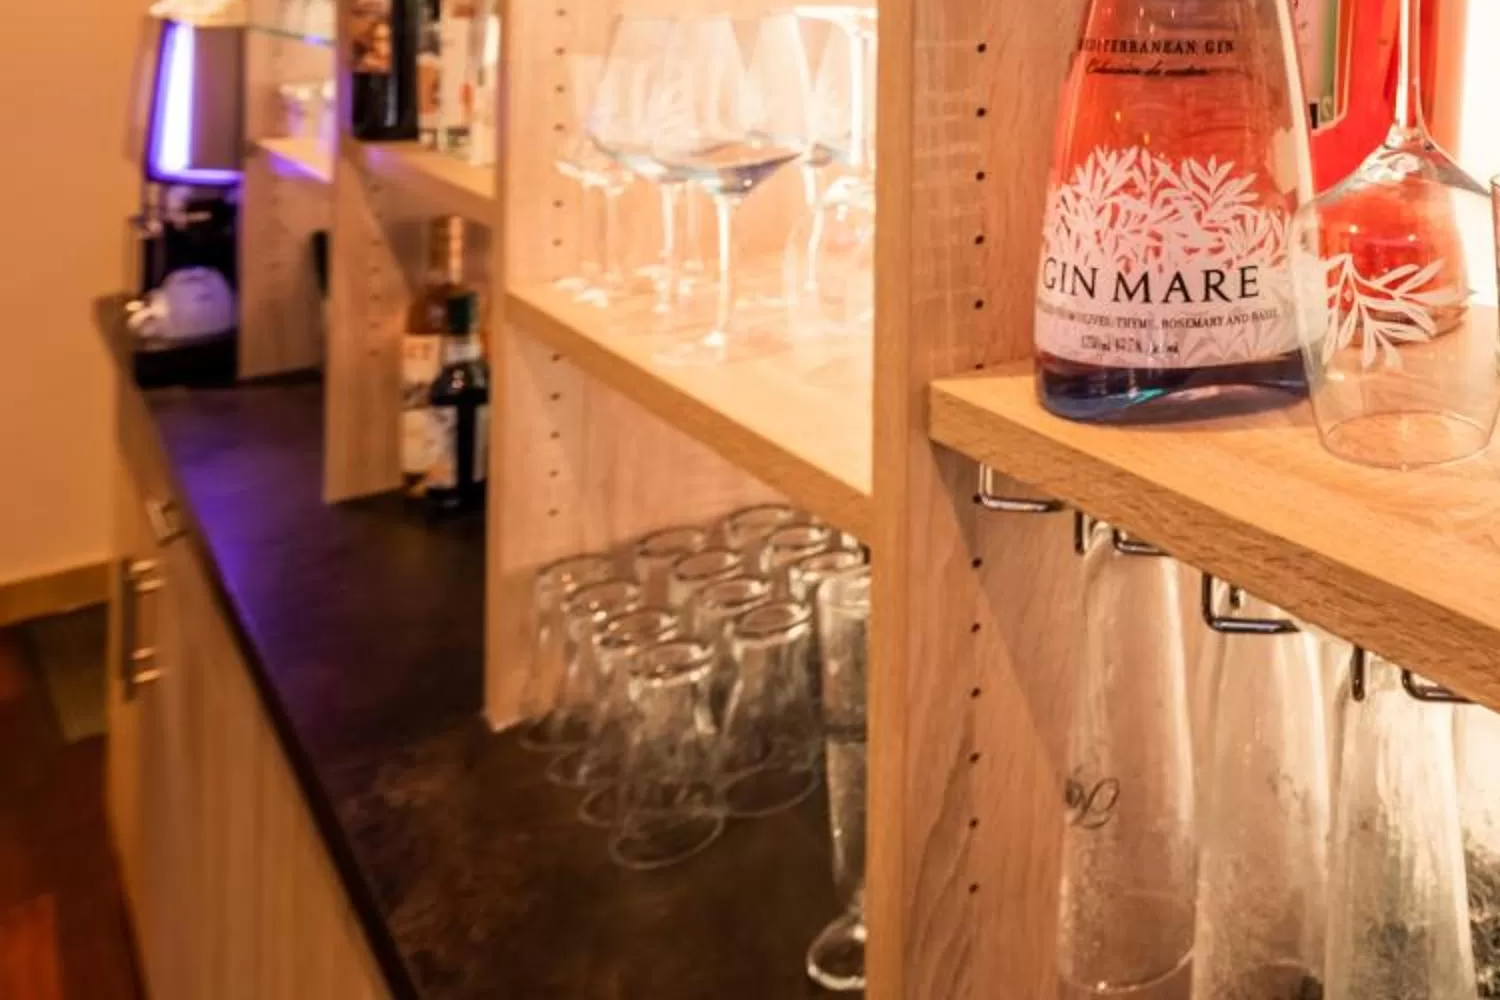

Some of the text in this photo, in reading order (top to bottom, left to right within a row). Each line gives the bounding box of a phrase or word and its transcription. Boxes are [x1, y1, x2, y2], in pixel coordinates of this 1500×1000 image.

[1043, 255, 1260, 304] GIN MARE
[1161, 314, 1224, 329] ROSEMARY
[1226, 312, 1249, 326] AND
